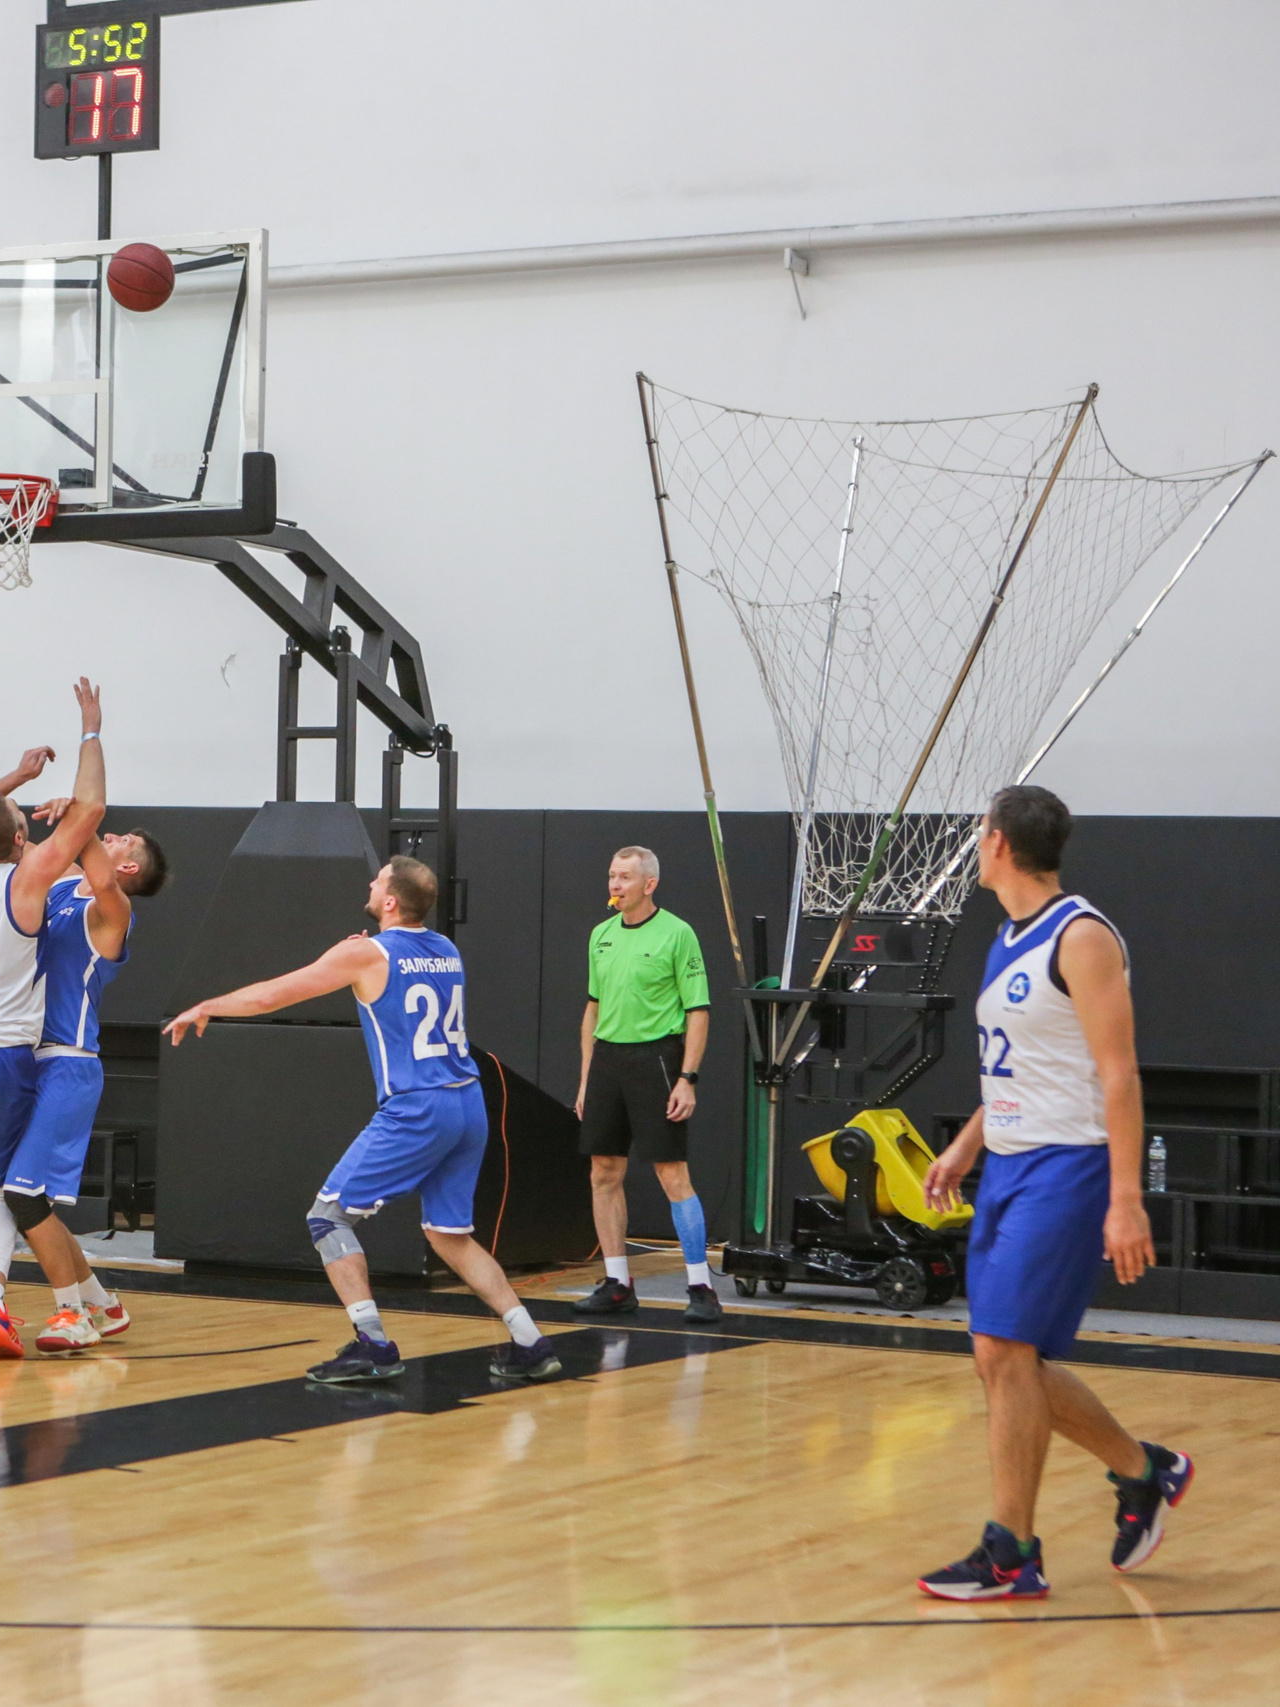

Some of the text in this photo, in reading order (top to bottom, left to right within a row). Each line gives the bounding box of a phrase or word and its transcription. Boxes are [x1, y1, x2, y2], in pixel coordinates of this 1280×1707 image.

[68, 21, 148, 66] 5:52
[91, 67, 143, 139] 17
[404, 983, 469, 1061] 24
